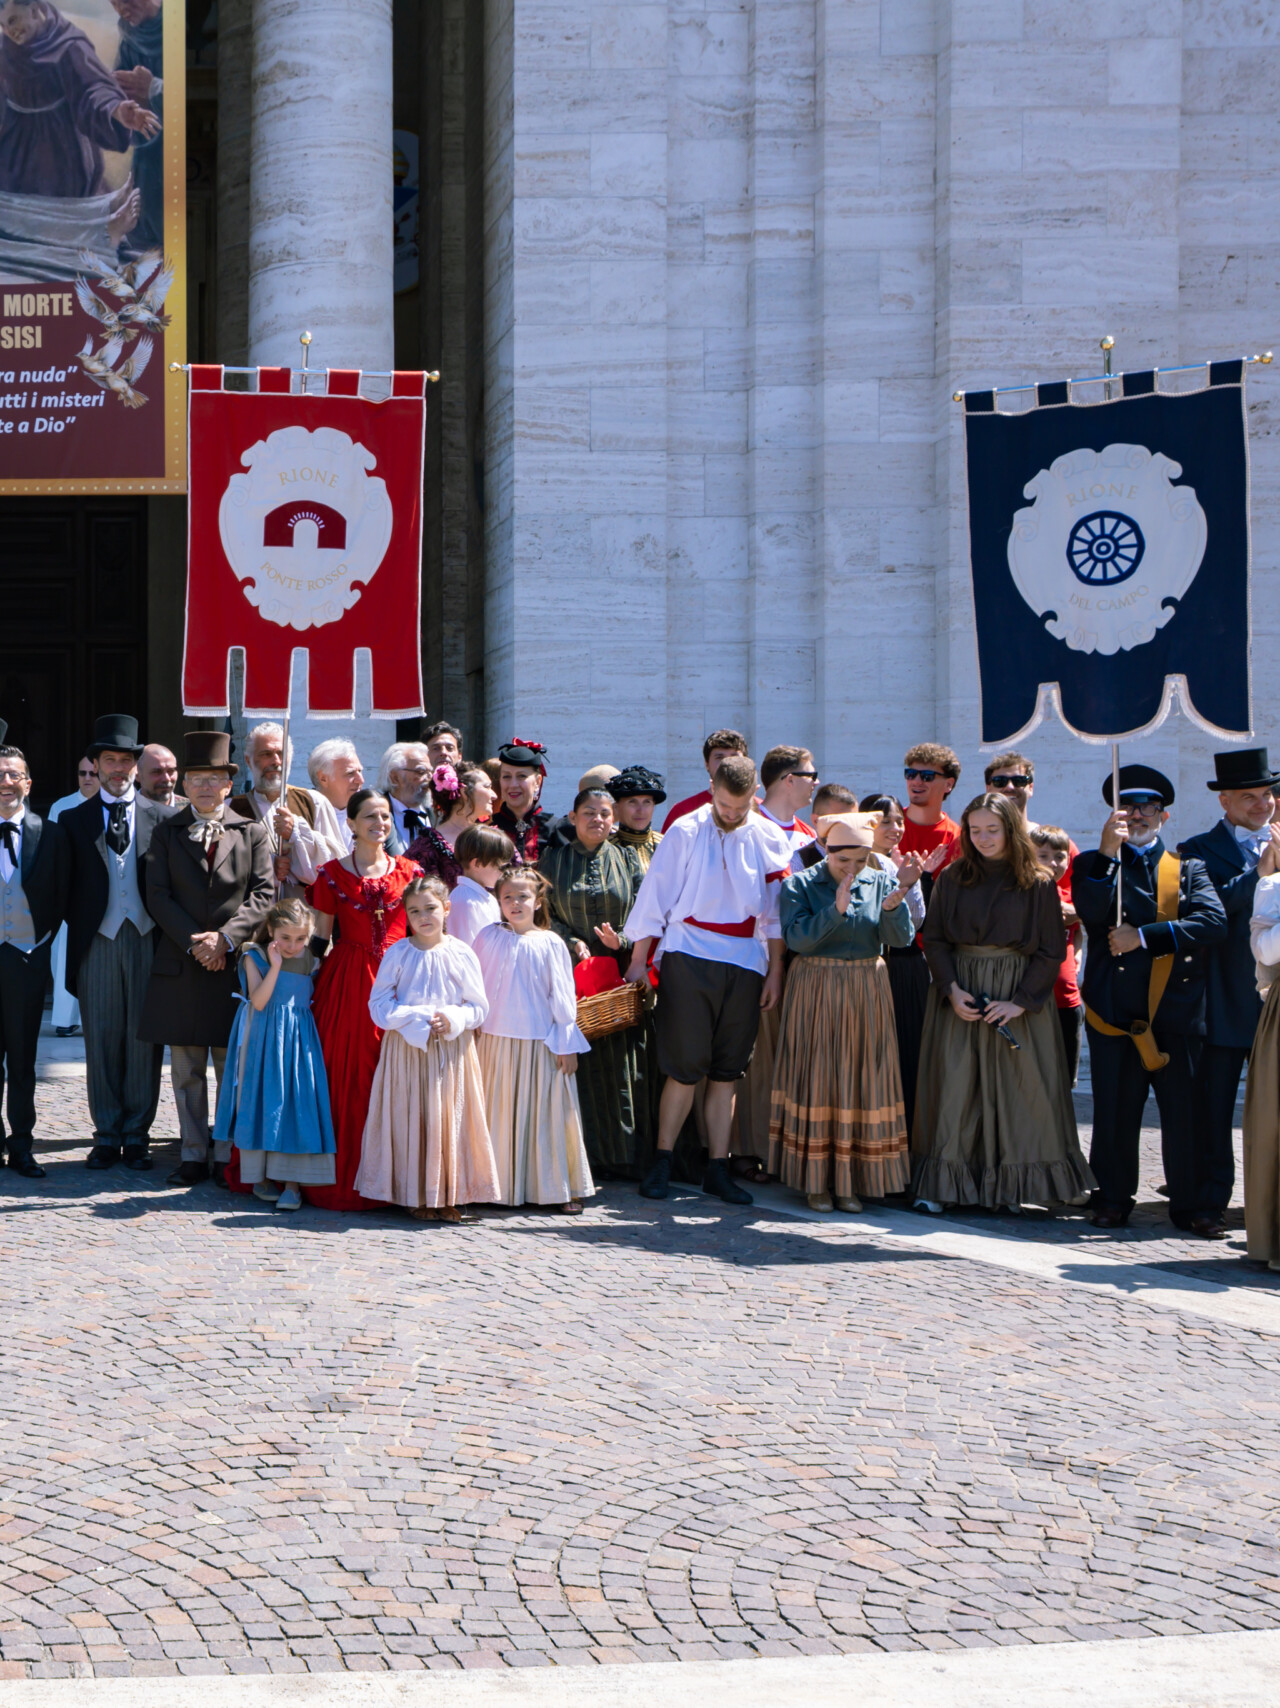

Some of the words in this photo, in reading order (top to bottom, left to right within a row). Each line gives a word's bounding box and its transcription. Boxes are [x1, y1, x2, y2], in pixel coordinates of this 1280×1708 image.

[4, 293, 73, 317] MORTE
[31, 392, 38, 408] i
[41, 391, 106, 408] misteri
[18, 421, 29, 433] a
[278, 467, 339, 489] RIONE
[1066, 482, 1138, 507] RIONE
[260, 562, 303, 591] PONTE
[307, 563, 348, 591] ROSSO
[1068, 592, 1093, 611] DEL
[1096, 584, 1150, 611] CAMPO
